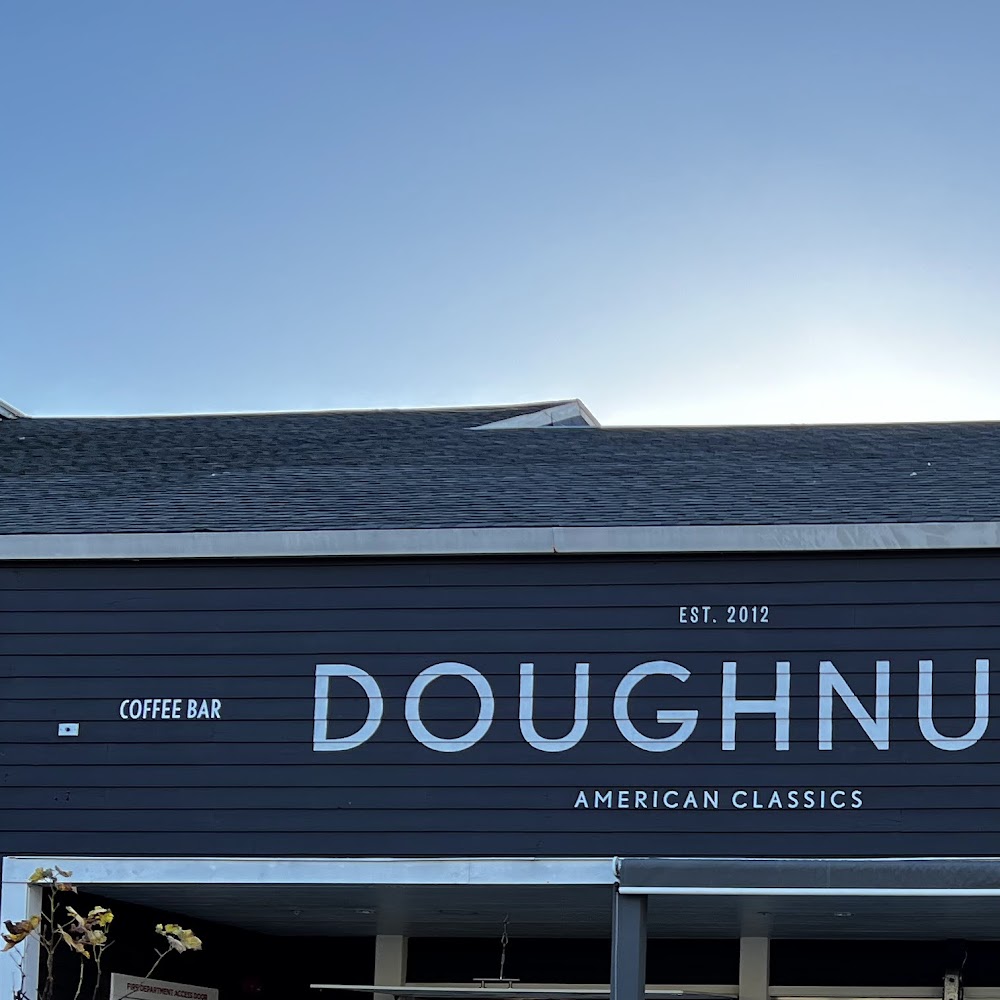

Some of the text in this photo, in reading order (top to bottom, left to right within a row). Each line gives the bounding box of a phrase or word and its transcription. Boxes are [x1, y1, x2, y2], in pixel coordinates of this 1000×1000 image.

[679, 605, 769, 624] EST. 2012
[119, 698, 222, 721] COFFEE BAR
[573, 789, 864, 809] AMERICAN CLASSICS
[139, 984, 174, 996] DEPARTMENT
[174, 989, 193, 999] ACCESS
[193, 992, 208, 1000] DOOR
